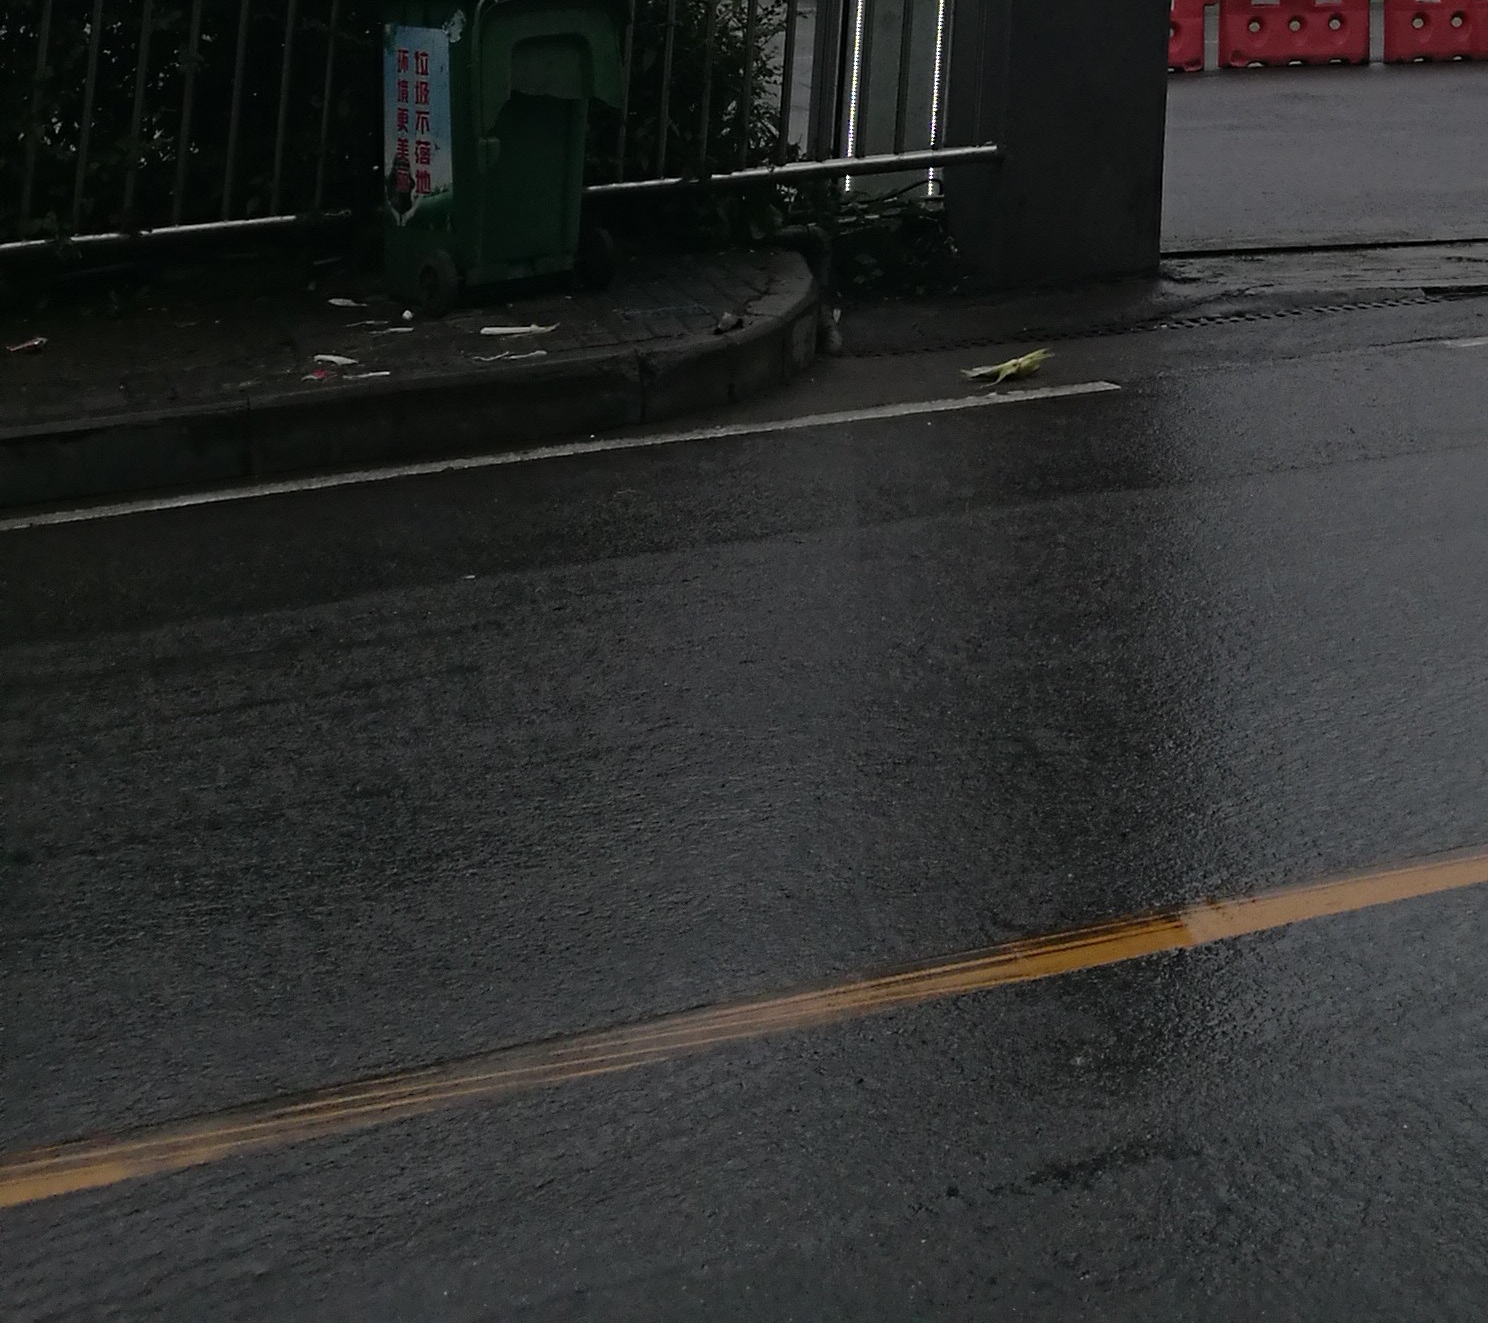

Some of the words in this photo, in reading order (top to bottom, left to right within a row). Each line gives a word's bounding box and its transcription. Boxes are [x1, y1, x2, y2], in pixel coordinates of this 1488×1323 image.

[414, 51, 432, 194] 垃圾不落地
